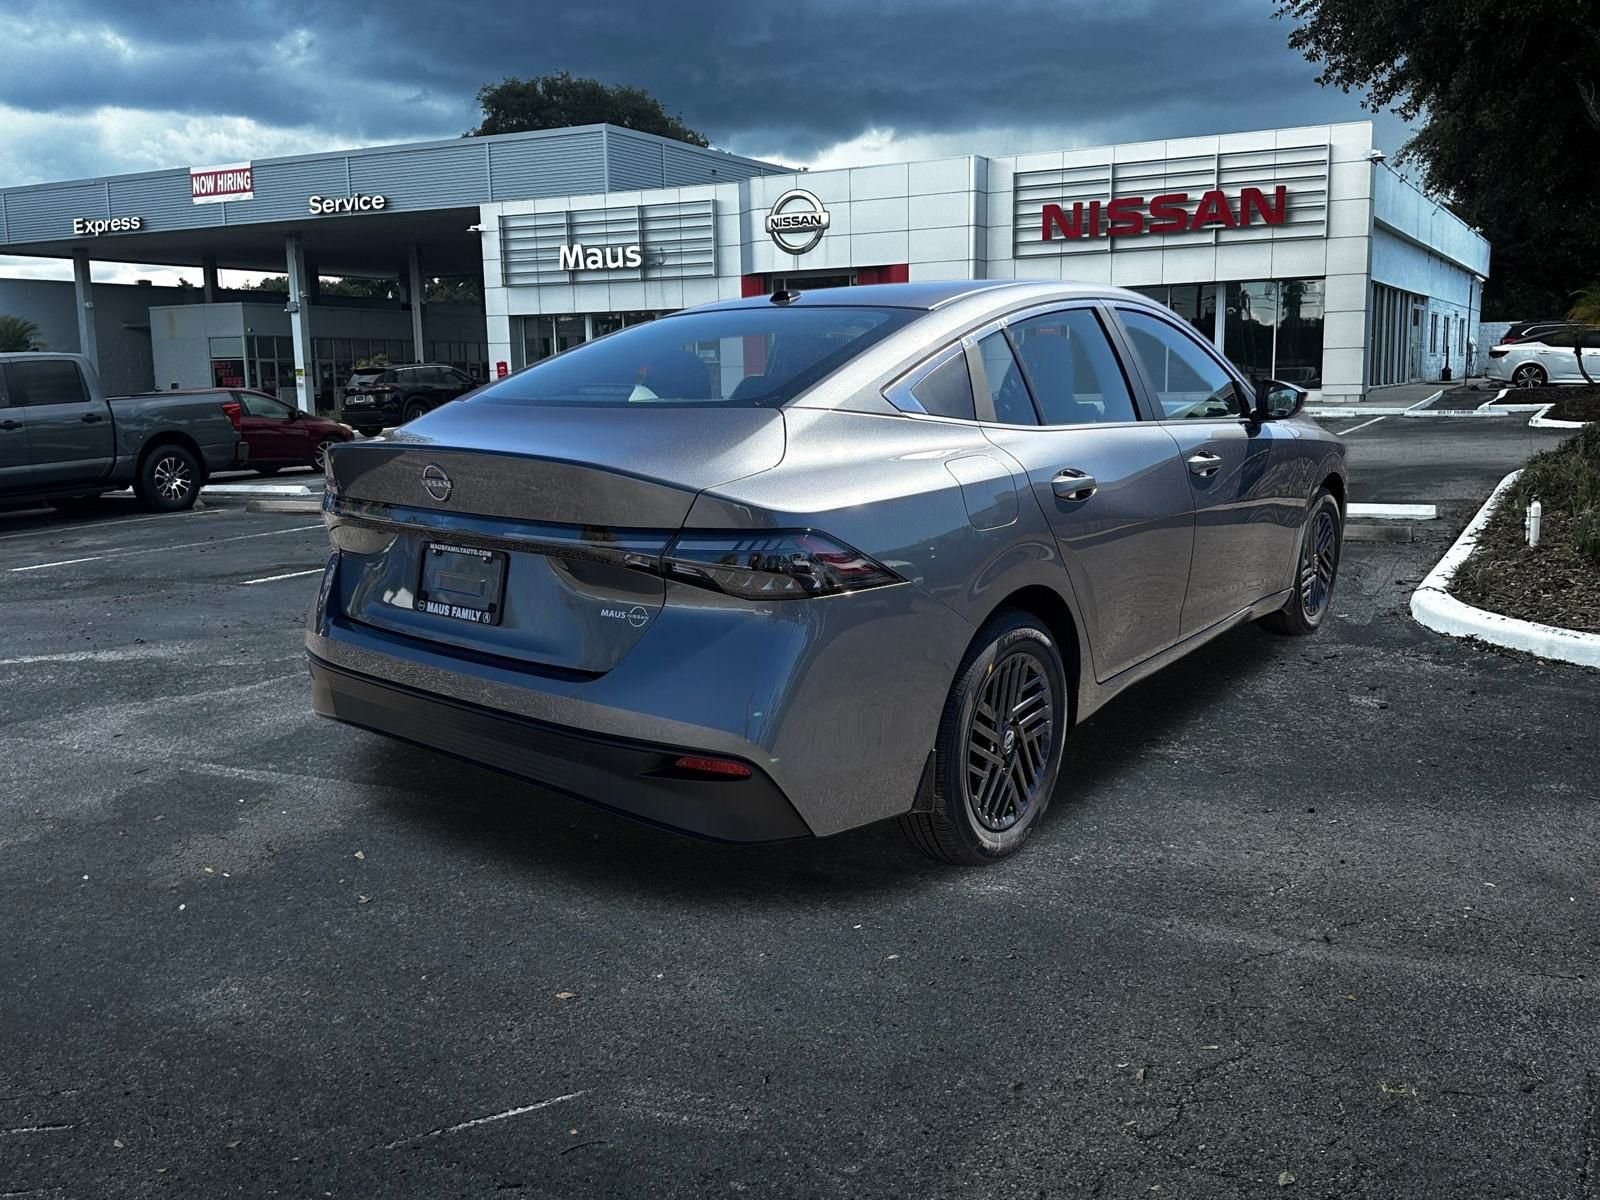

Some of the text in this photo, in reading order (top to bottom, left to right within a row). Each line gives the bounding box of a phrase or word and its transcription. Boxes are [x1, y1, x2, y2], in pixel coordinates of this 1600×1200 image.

[192, 171, 251, 195] NOW HIRING
[309, 193, 385, 215] Service
[1041, 185, 1288, 241] NISSAN
[73, 216, 141, 237] Express
[770, 215, 822, 228] NISSAN
[559, 243, 642, 271] Maus
[429, 543, 492, 558] MAUSFAMILYAUTO.COM
[426, 601, 482, 622] MAUS FAMILY
[600, 609, 627, 619] MAUS
